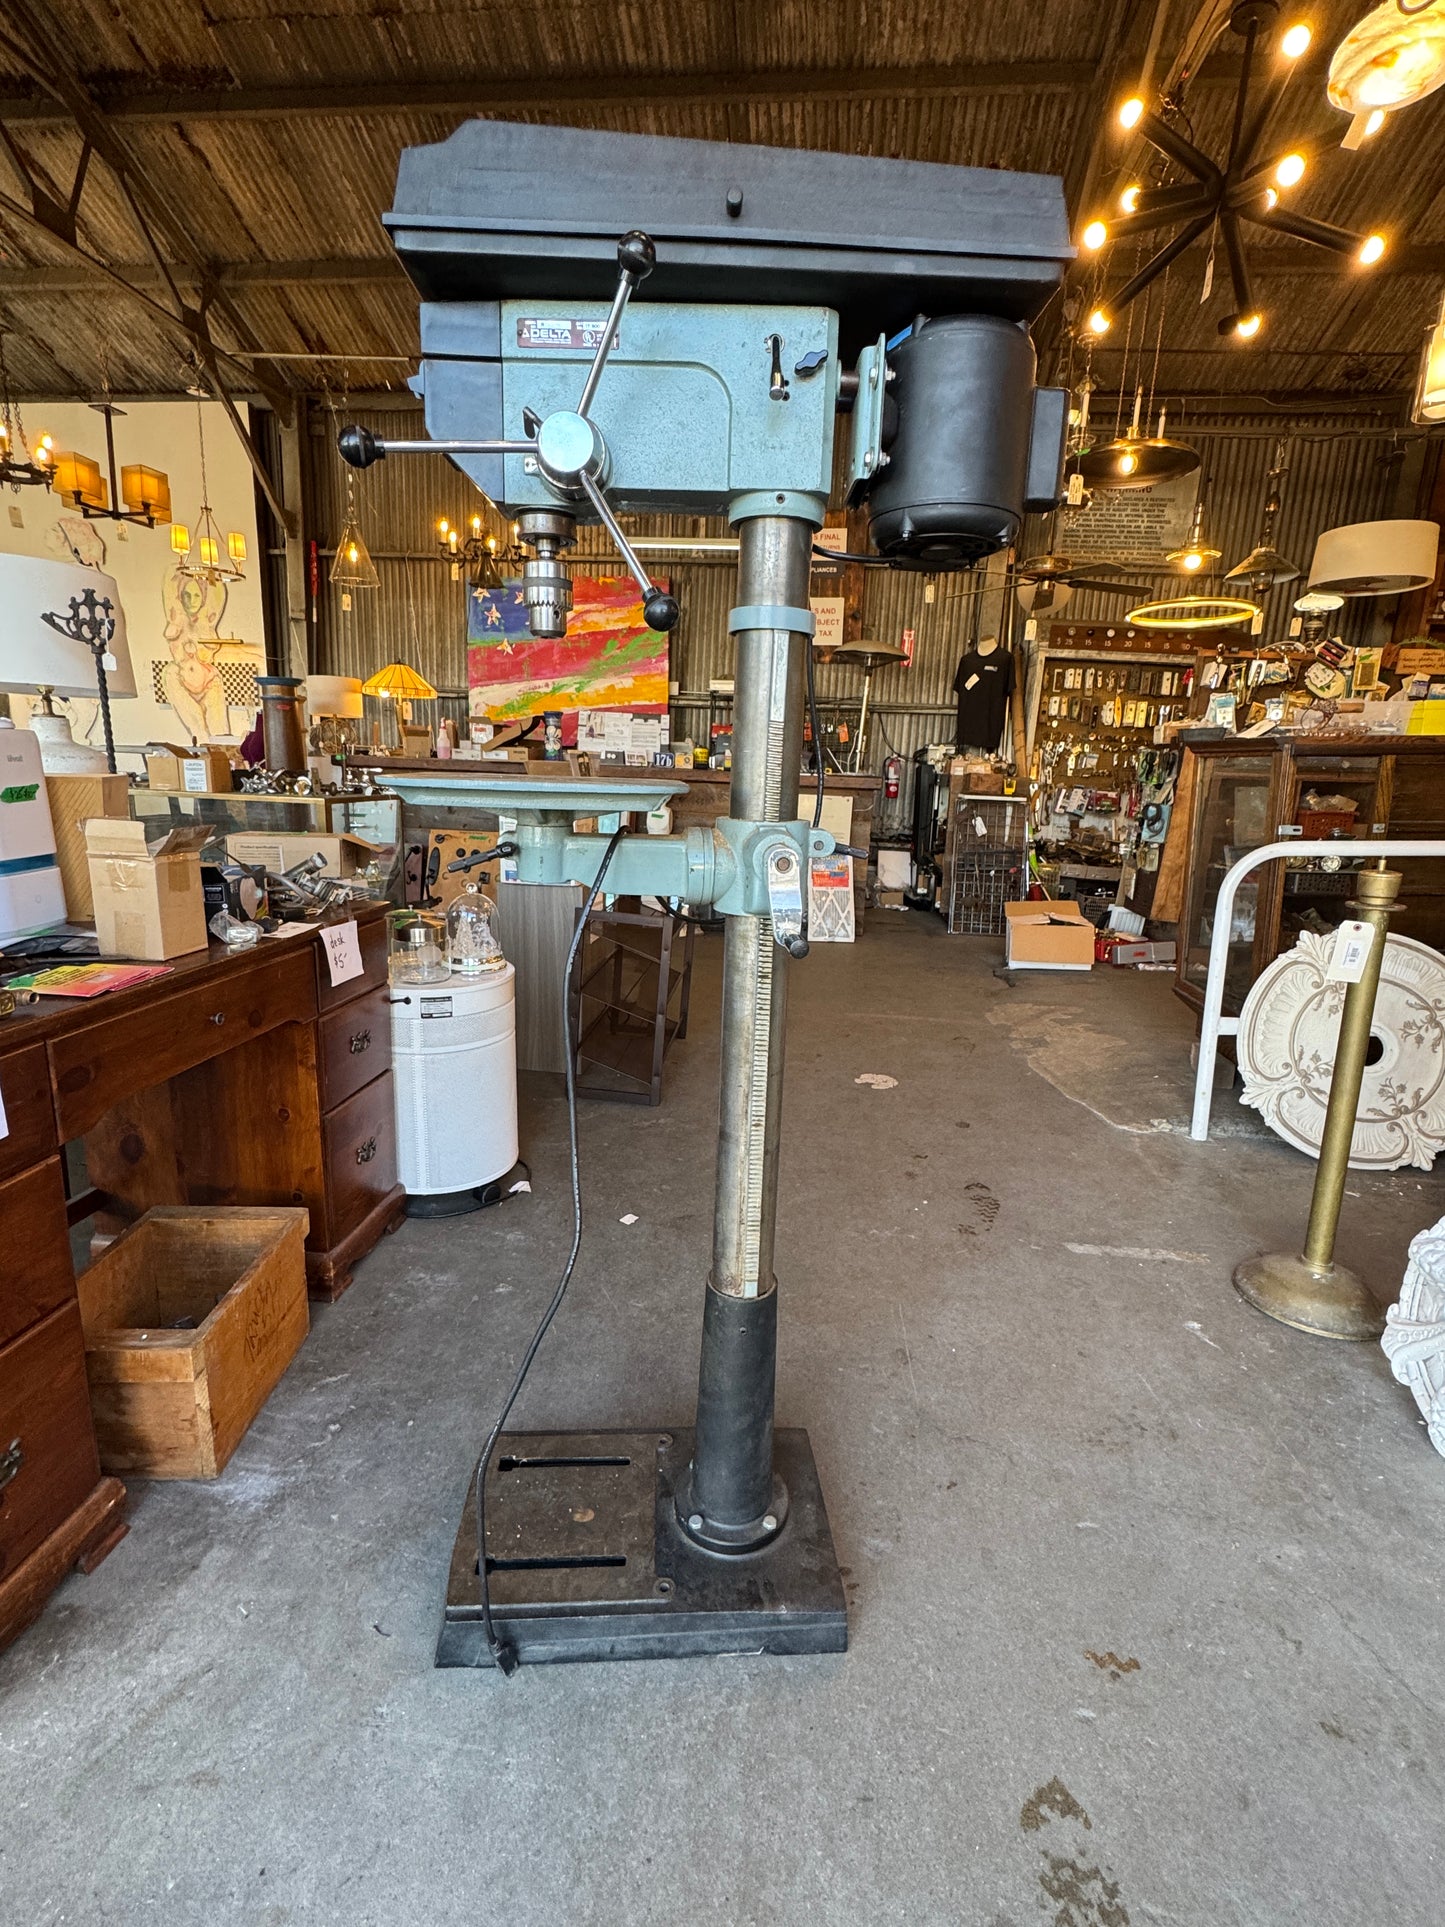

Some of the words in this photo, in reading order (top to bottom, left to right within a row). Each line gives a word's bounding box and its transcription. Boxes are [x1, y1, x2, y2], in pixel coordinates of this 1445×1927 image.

[531, 329, 571, 339] DELTA
[656, 754, 672, 767] 17b
[330, 931, 346, 949] desk
